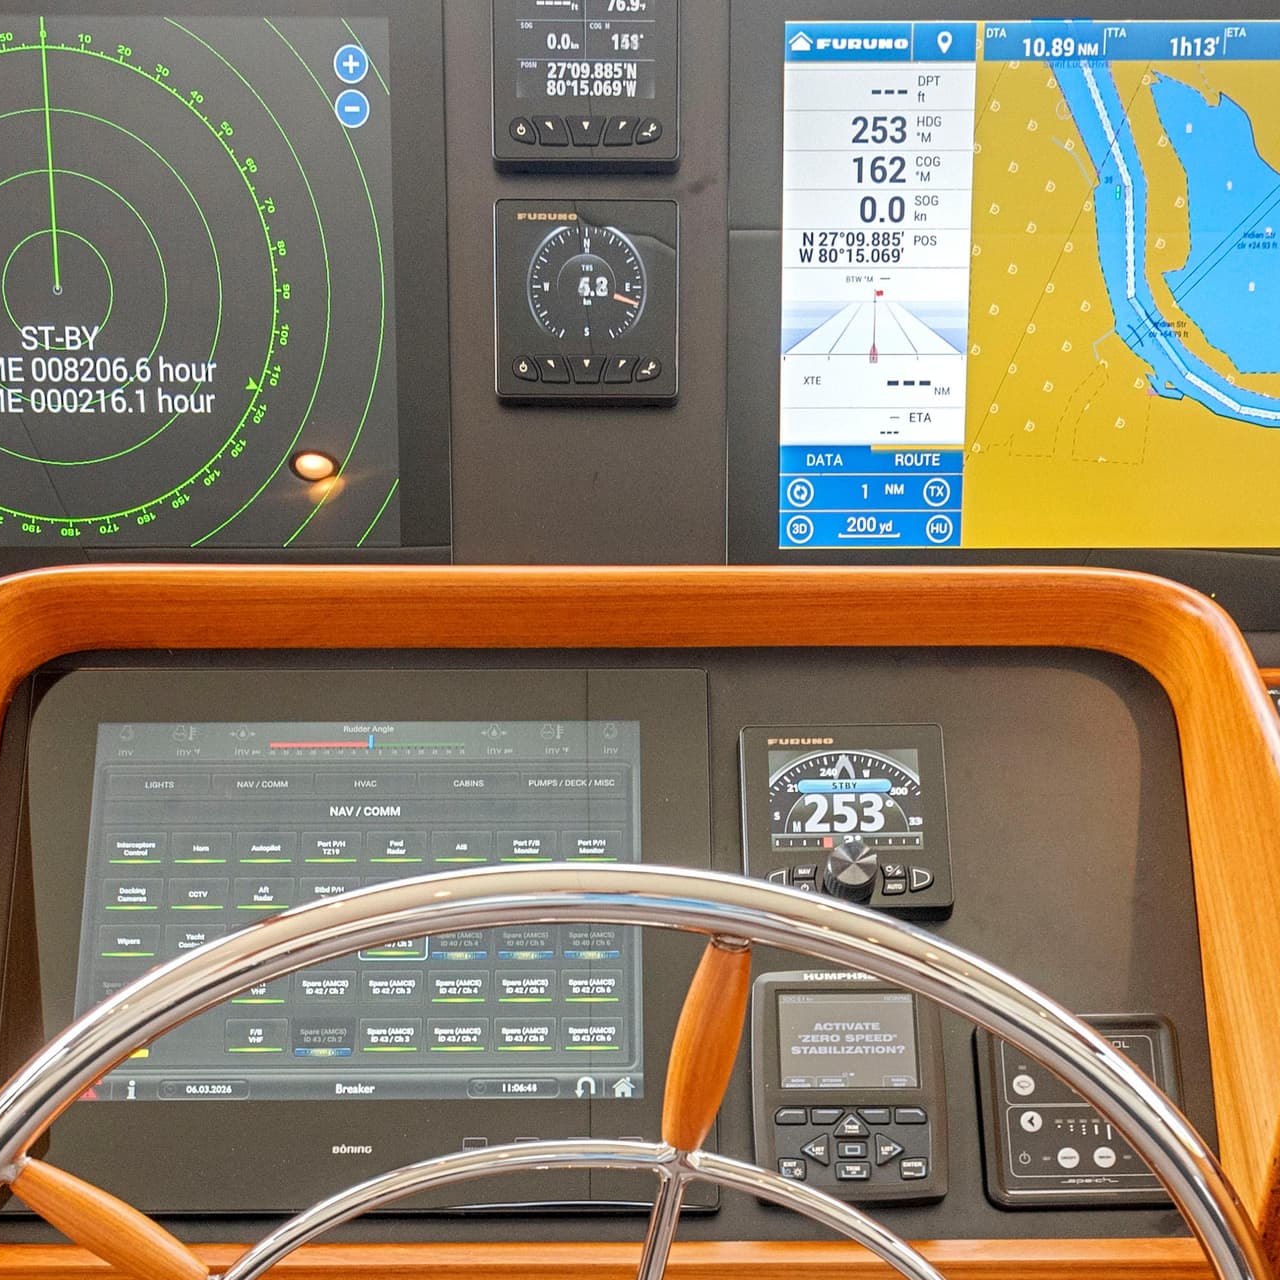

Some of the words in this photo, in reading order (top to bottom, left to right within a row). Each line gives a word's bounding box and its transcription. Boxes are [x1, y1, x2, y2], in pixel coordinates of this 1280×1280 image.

[78, 34, 91, 43] 10
[986, 28, 1007, 38] DTA
[1107, 28, 1126, 38] TTA
[1227, 28, 1247, 38] ETA
[547, 33, 570, 50] 0.0
[816, 39, 908, 49] FURUNO
[117, 45, 132, 56] 20
[1023, 39, 1075, 57] 10.89
[1079, 43, 1098, 56] NM
[155, 64, 170, 77] 30
[918, 76, 940, 86] DPT
[190, 90, 204, 104] 40
[918, 92, 925, 102] ft
[852, 116, 907, 143] 253
[917, 116, 942, 127] HDG
[853, 157, 906, 183] 162
[916, 157, 941, 167] COG
[860, 196, 905, 223] 0.0
[914, 195, 939, 206] SOG
[914, 211, 927, 221] kn
[803, 232, 814, 246] N
[914, 236, 937, 246] POS
[799, 249, 813, 262] W
[283, 284, 290, 299] 90
[21, 325, 99, 351] ST-BY
[31, 357, 151, 382] 008206.6
[159, 356, 217, 382] hour
[804, 376, 821, 385] XTE
[934, 387, 950, 395] NM
[30, 389, 145, 413] 000216.1
[158, 388, 216, 413] hour
[909, 413, 931, 423] ETA
[806, 454, 843, 466] DATA
[895, 454, 940, 466] ROUTE
[862, 484, 868, 499] 1
[885, 484, 904, 495] NM
[929, 486, 944, 497] TX
[792, 523, 807, 534] 3D
[847, 517, 876, 532] 200
[880, 520, 893, 534] yd
[931, 523, 947, 533] HU
[832, 782, 858, 790] STBY
[330, 807, 354, 816] NAV
[364, 807, 400, 816] COMM
[188, 890, 208, 898] CCTV
[814, 1022, 880, 1030] ACTIVATE
[791, 1046, 905, 1054] STABILIZATION?
[186, 1086, 232, 1094] 06.03.2026
[335, 1084, 375, 1094] Breaker
